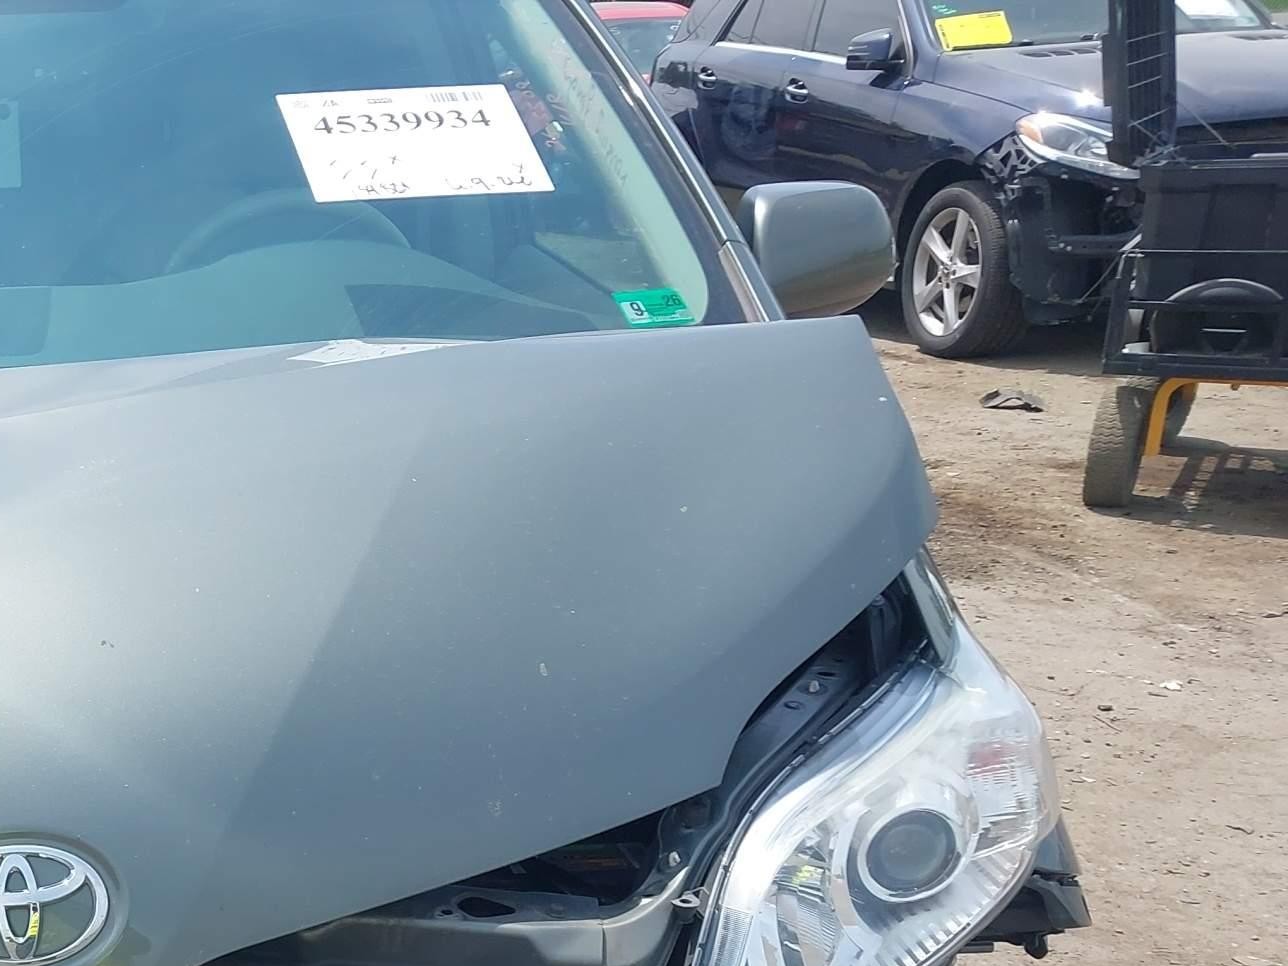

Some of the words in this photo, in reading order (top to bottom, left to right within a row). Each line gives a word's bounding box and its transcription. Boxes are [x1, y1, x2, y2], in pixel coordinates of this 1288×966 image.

[313, 108, 491, 135] 45339934
[662, 294, 681, 307] 26
[630, 302, 648, 317] 9
